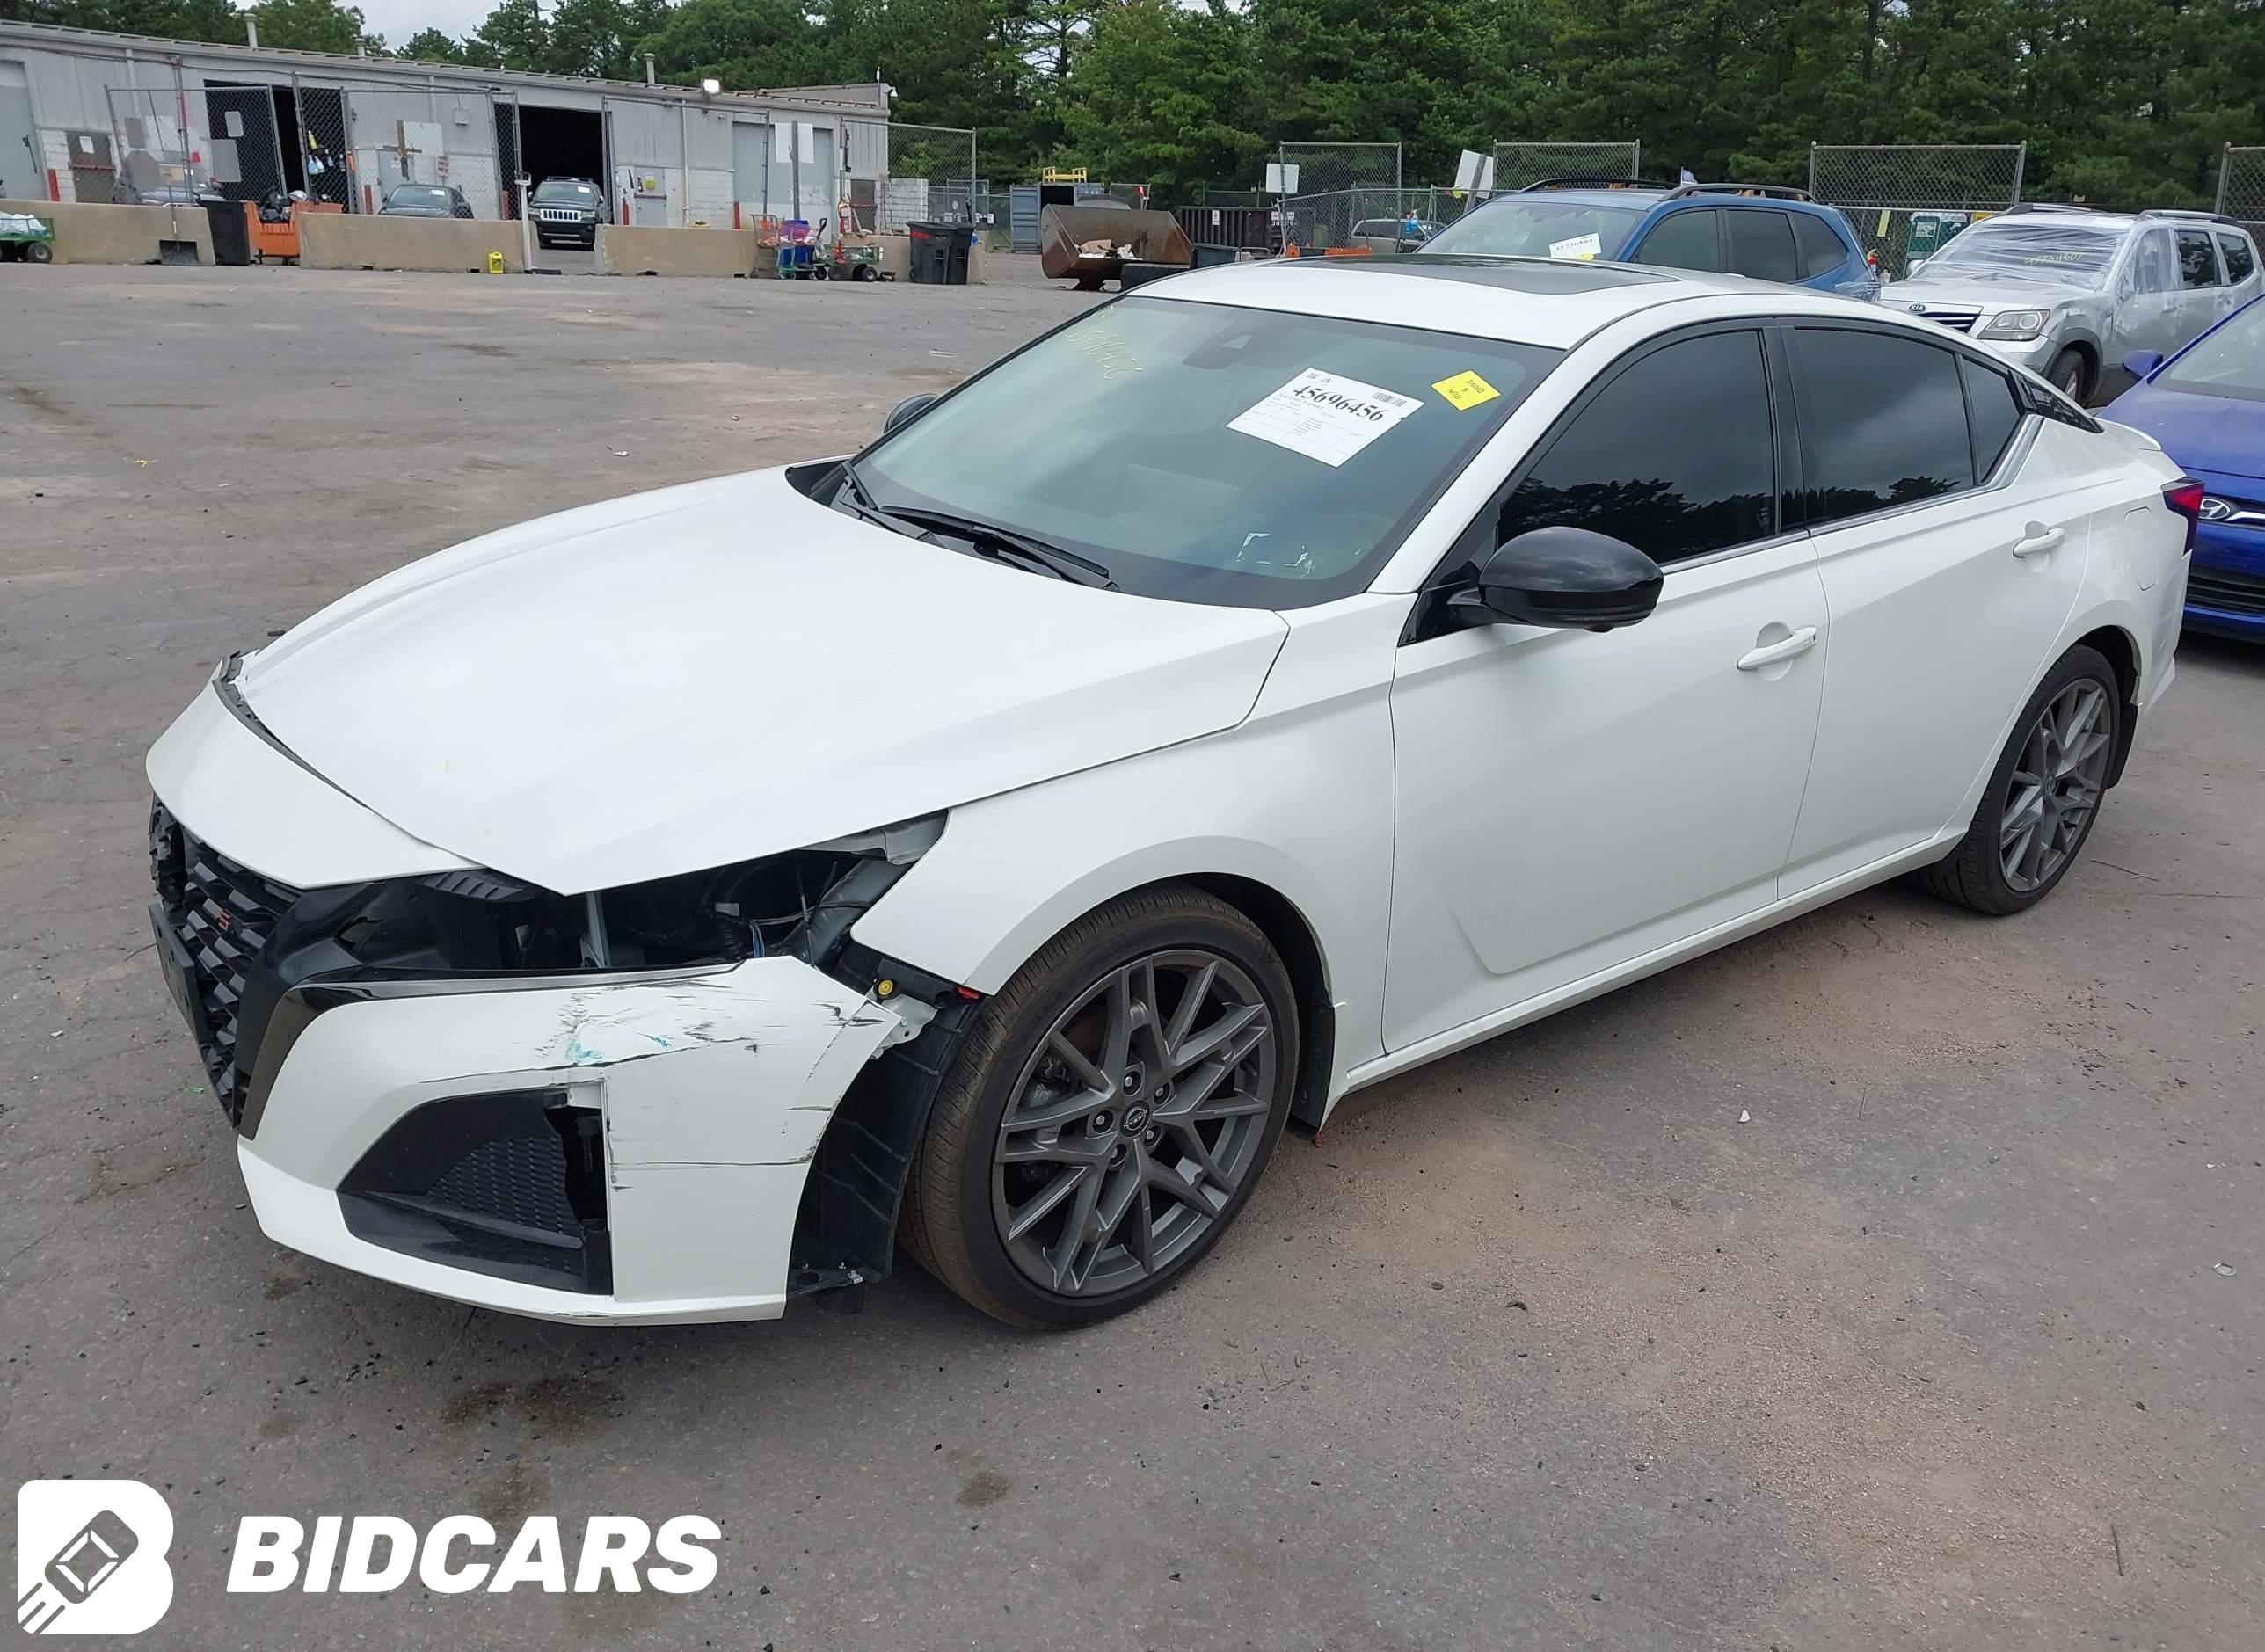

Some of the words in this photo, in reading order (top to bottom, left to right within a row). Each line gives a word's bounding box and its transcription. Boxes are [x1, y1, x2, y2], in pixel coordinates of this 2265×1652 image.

[1910, 303, 1925, 312] KIA
[1464, 379, 1485, 394] DRIVE
[1447, 389, 1463, 400] RUN
[1293, 385, 1391, 422] 45696456
